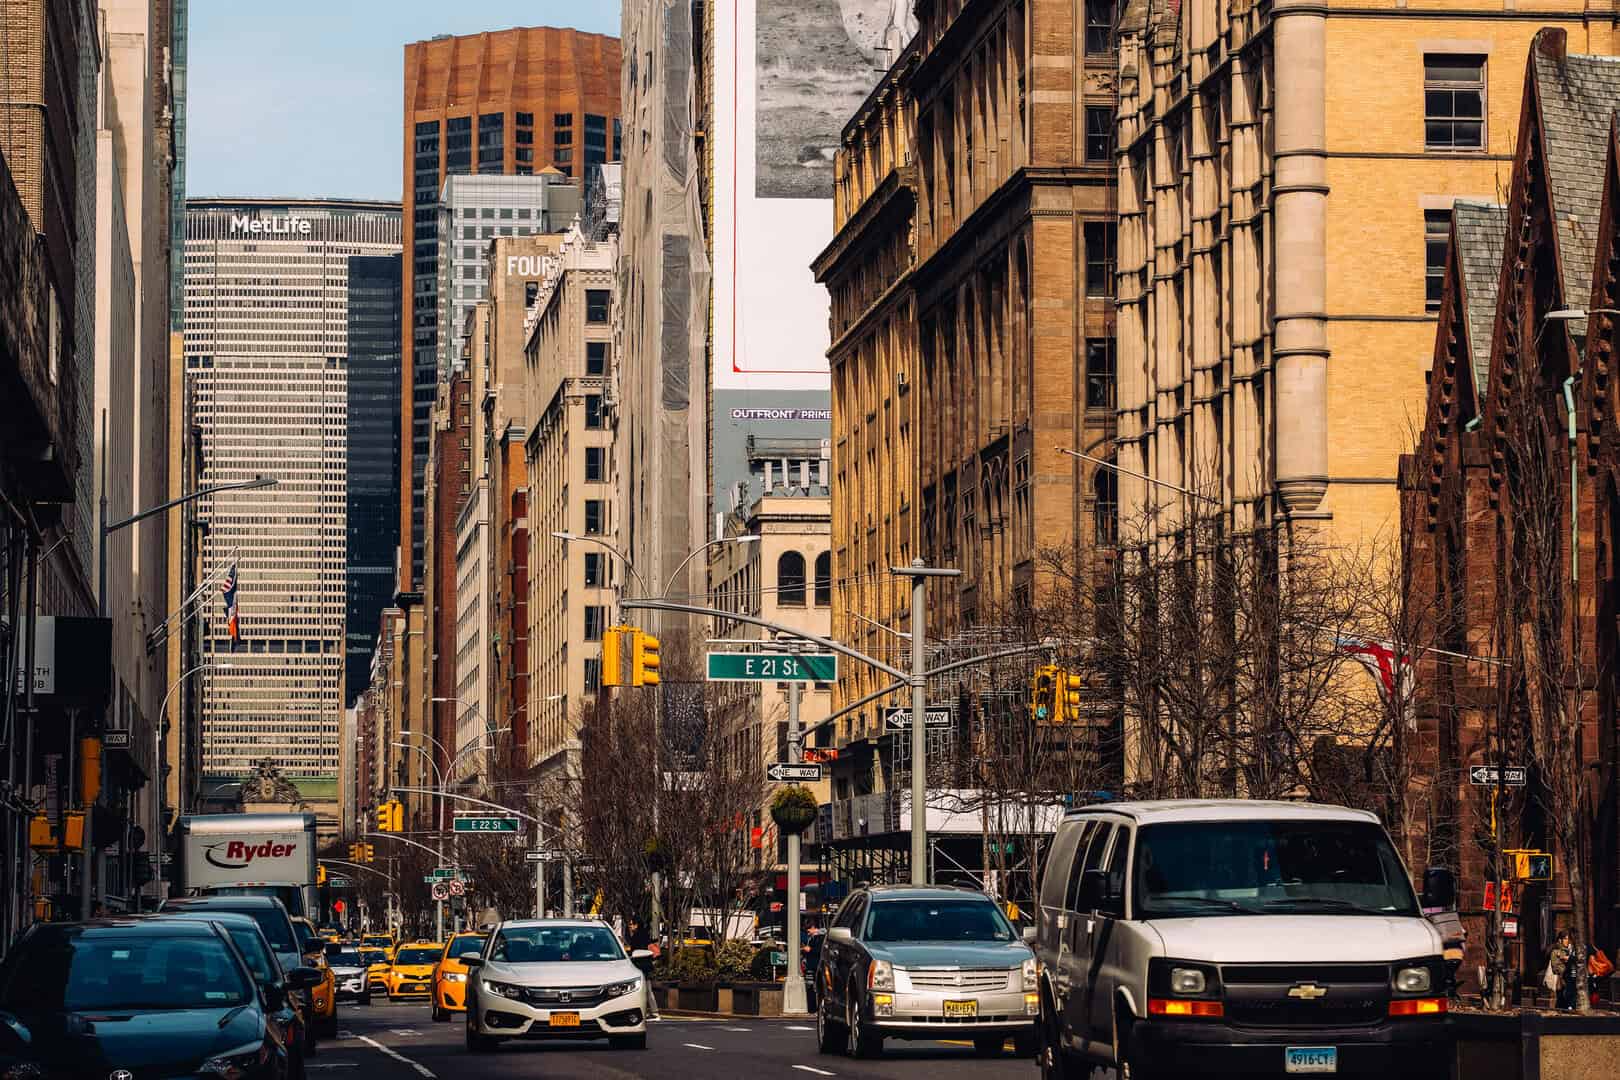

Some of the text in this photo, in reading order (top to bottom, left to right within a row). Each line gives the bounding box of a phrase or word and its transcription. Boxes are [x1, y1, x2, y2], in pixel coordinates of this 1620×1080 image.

[231, 215, 312, 233] MetLife
[732, 409, 795, 420] OUTFRONT
[745, 659, 799, 676] E 21 St
[892, 712, 945, 723] ONE WAY
[772, 768, 817, 777] ONE WAY
[471, 820, 501, 829] E 22 St
[226, 840, 296, 862] Ryder
